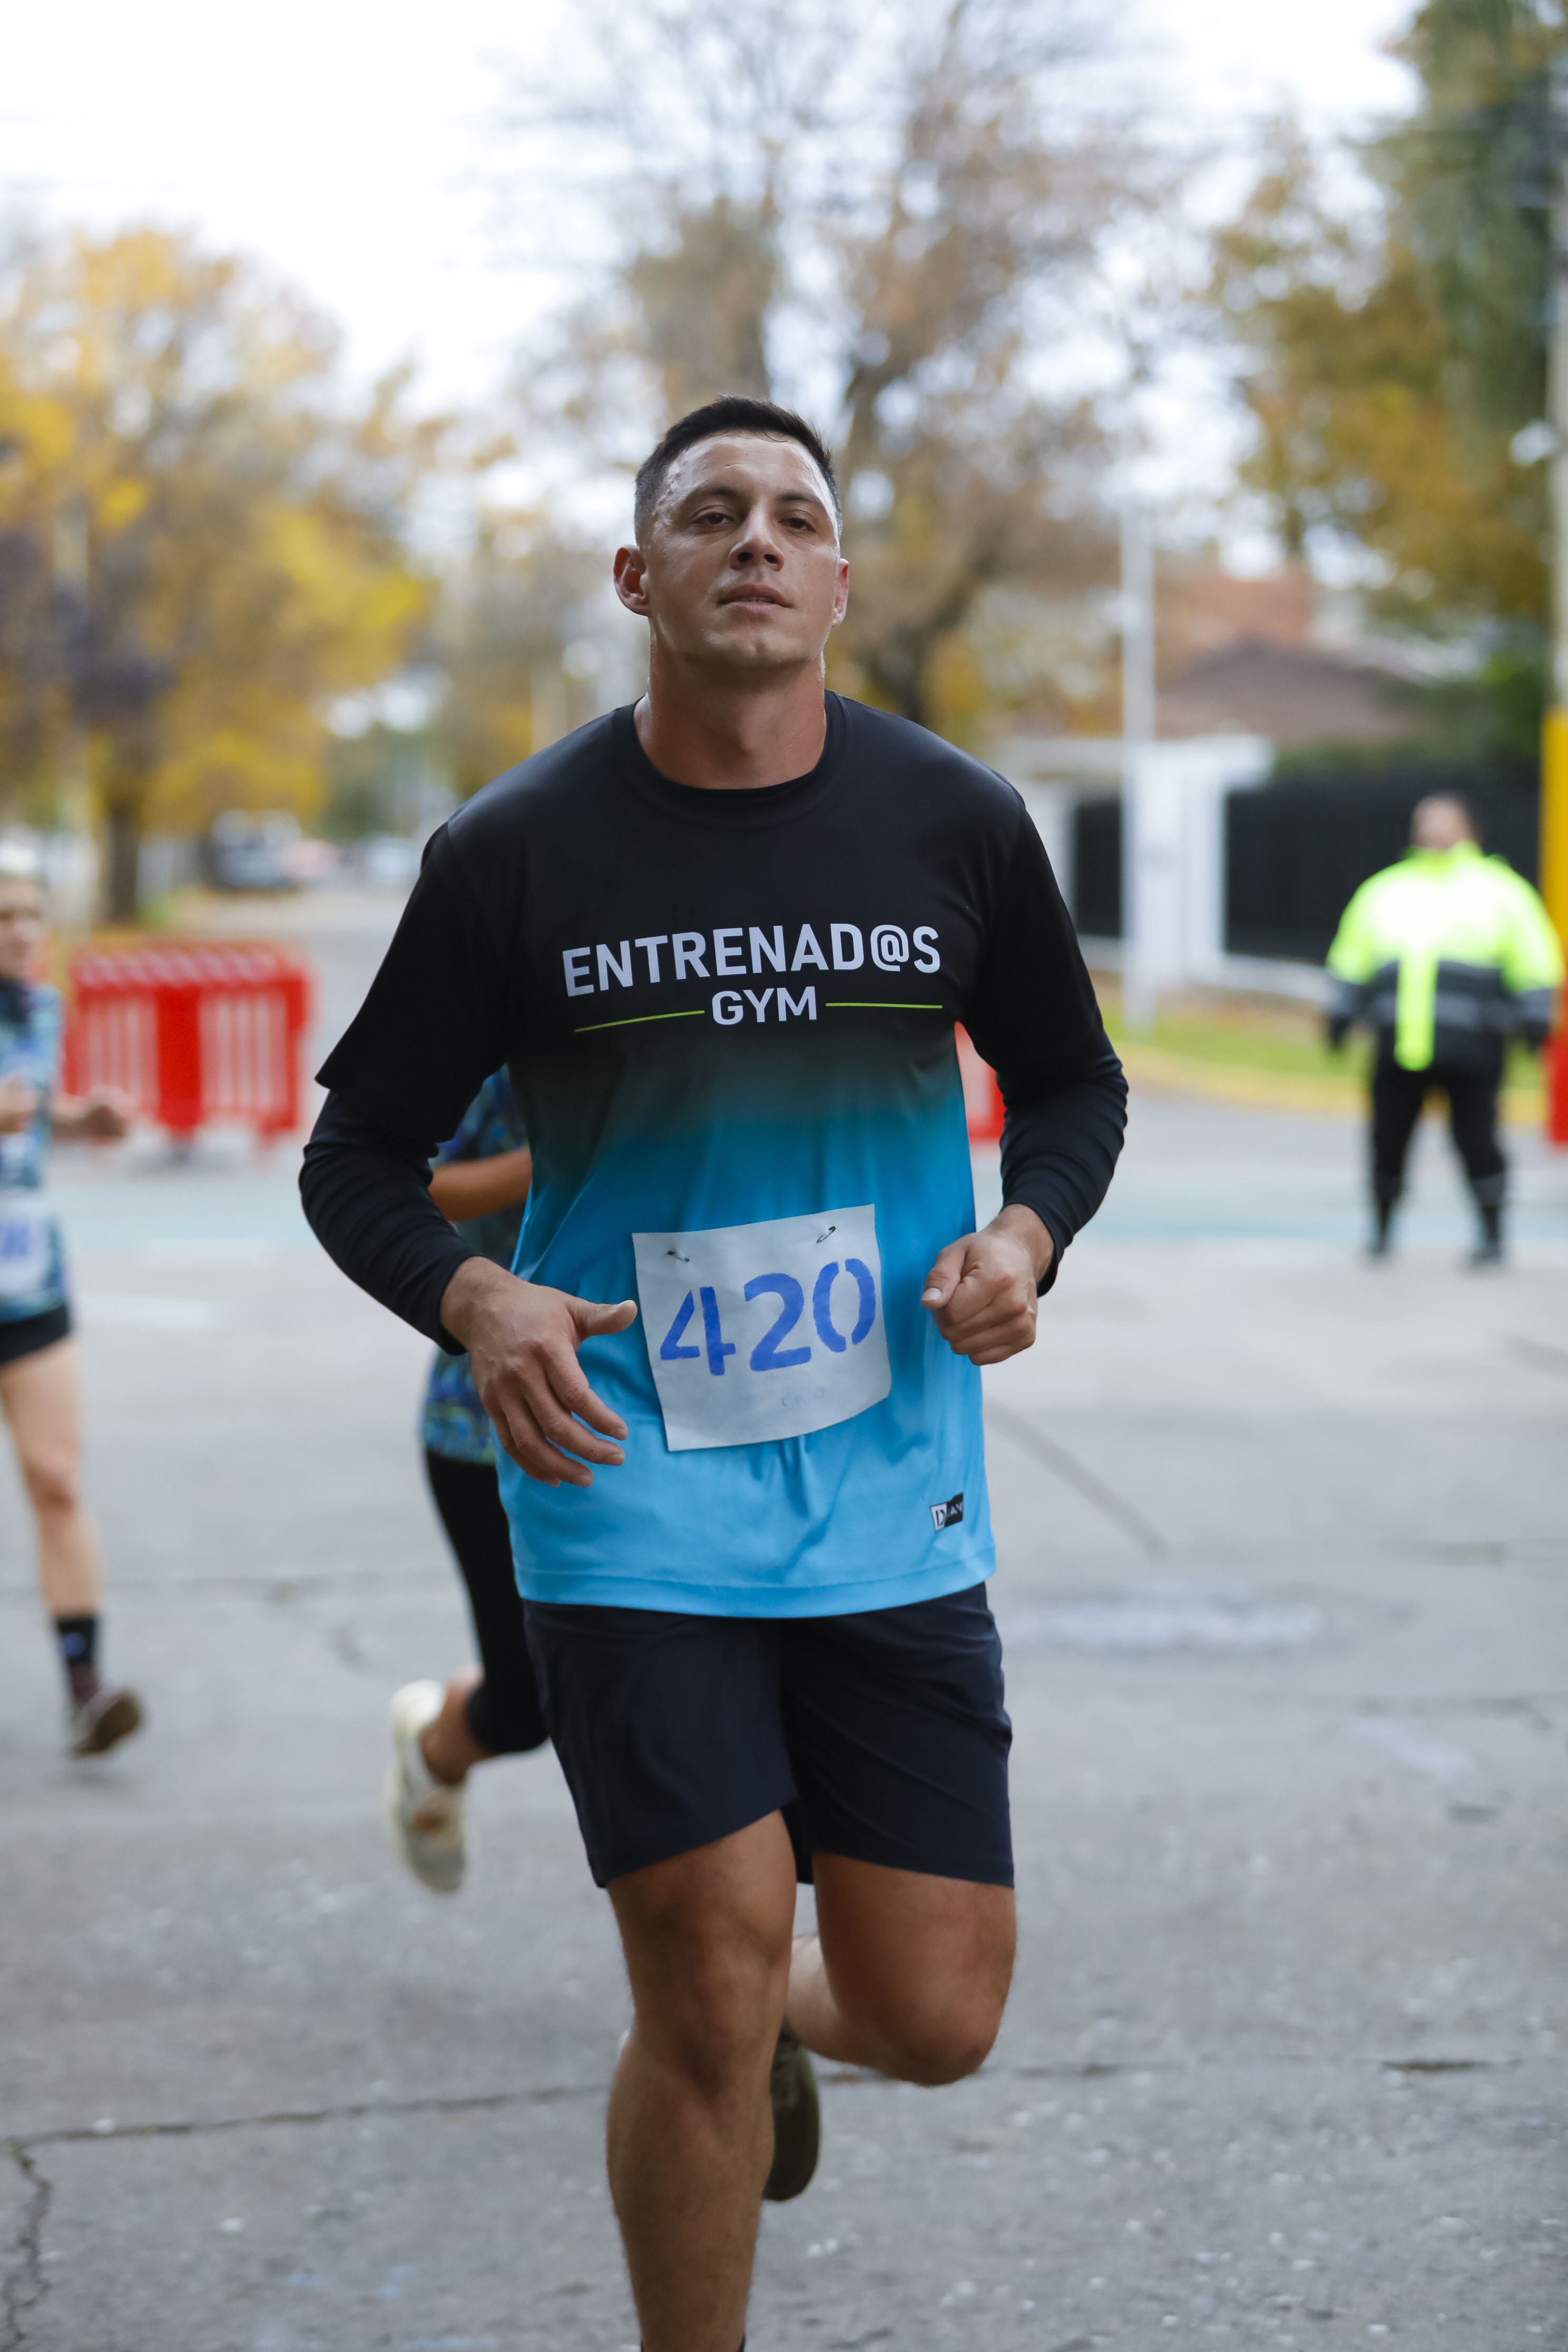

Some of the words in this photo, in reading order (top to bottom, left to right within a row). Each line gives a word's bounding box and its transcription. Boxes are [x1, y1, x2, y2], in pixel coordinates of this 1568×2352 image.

[562, 923, 940, 997] ENTRENAD@S
[712, 986, 817, 1025] GYM
[660, 1258, 877, 1376] 420
